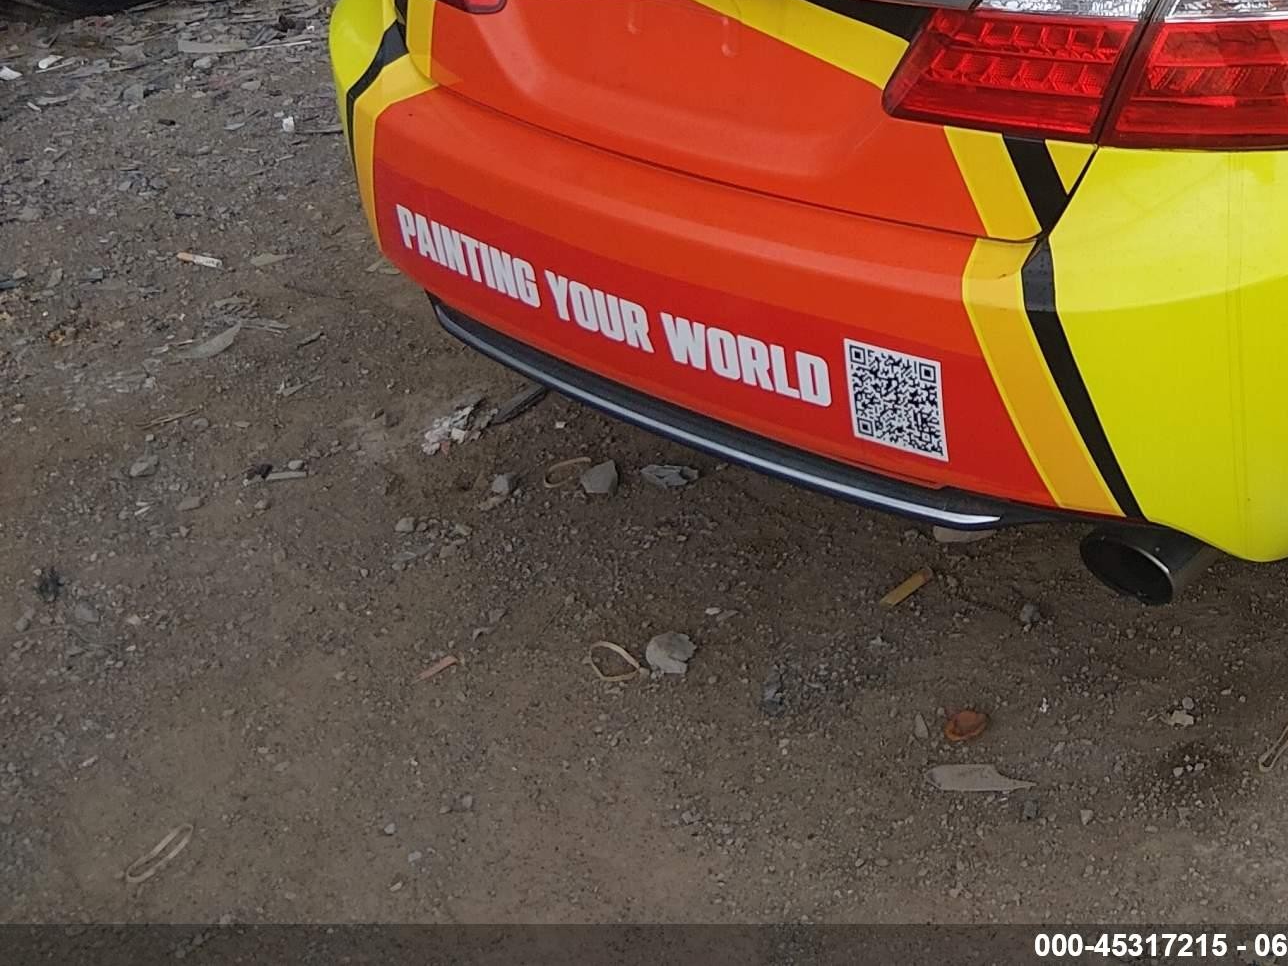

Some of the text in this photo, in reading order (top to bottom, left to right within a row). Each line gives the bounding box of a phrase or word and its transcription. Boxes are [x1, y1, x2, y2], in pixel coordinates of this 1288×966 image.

[396, 204, 832, 407] PAINTING YOUR WORLD
